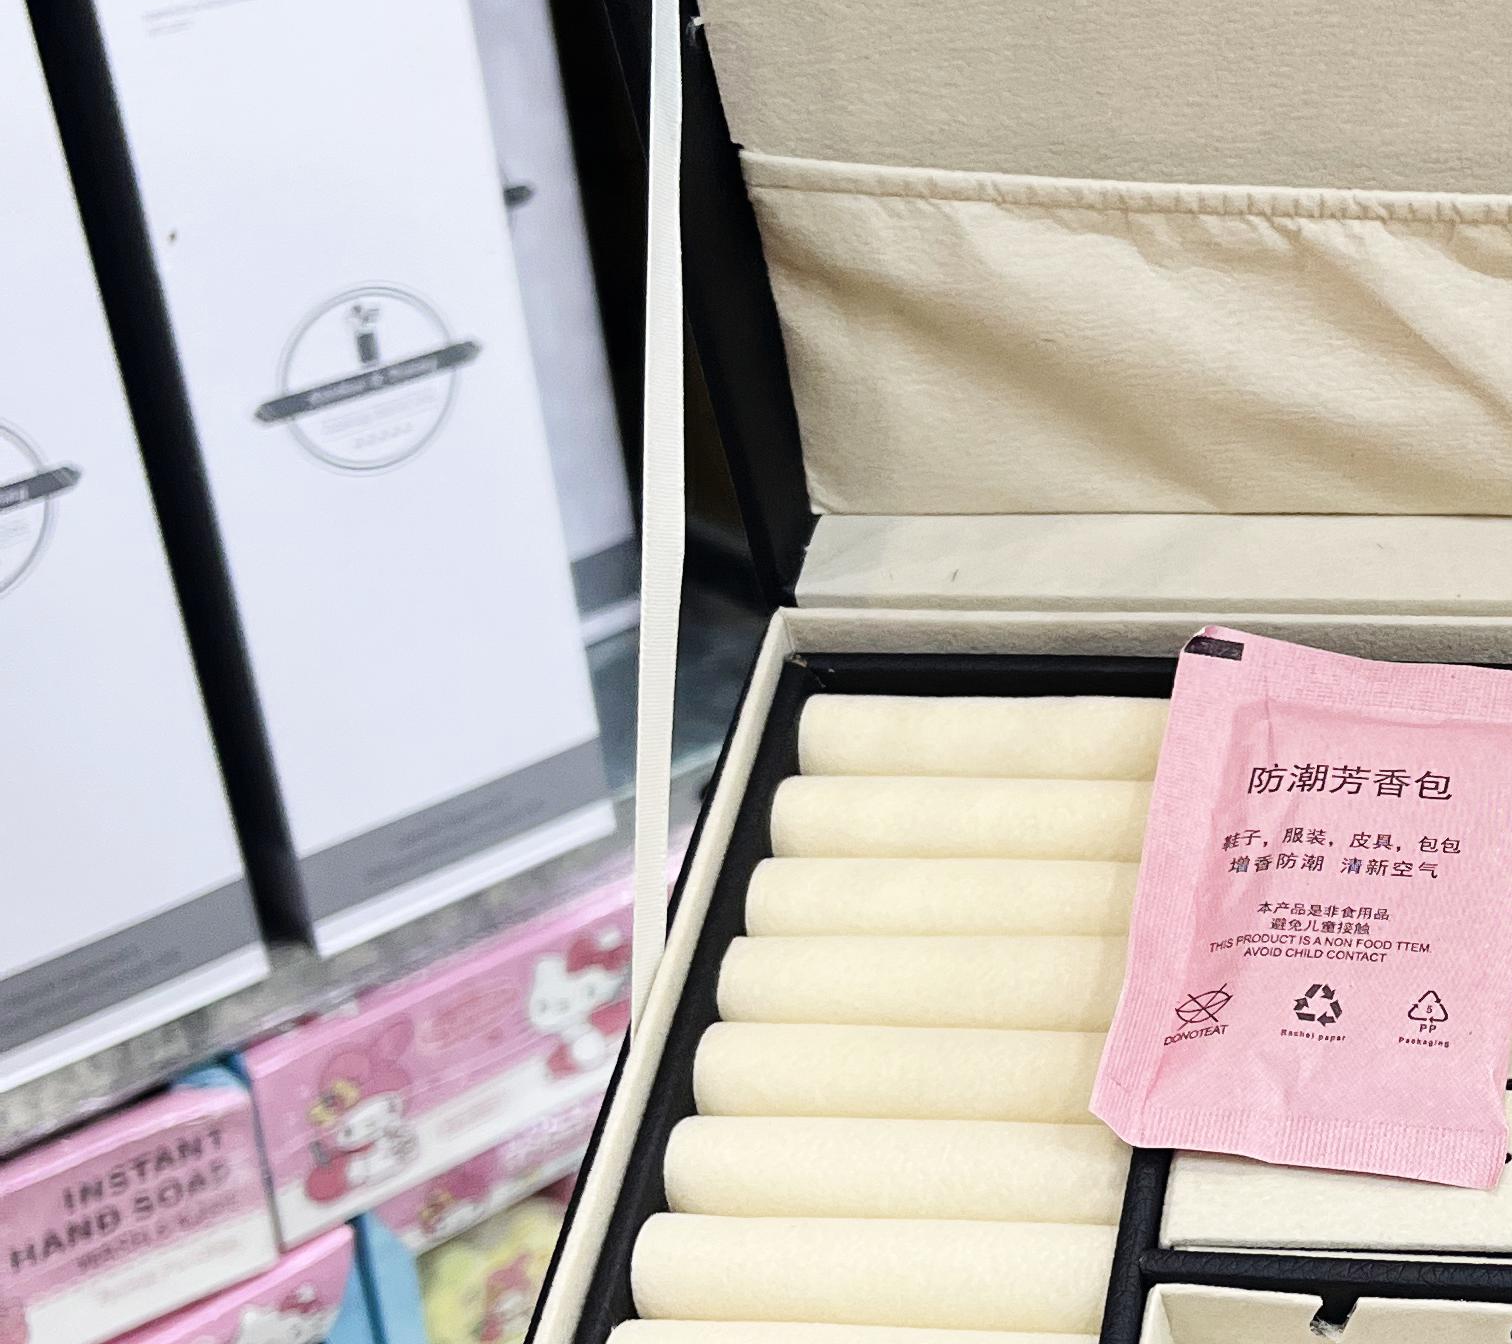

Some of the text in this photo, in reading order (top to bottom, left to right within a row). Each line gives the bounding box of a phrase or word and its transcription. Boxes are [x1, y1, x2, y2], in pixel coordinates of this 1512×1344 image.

[1247, 763, 1453, 801] 防潮芳香包
[1228, 853, 1439, 879] 增香防潮 清新空气
[1256, 901, 1390, 921] 本产品是非食用品
[1270, 917, 1371, 935] 避免儿童接触
[1209, 938, 1234, 953] THIS
[1236, 933, 1296, 947] PRODUCT
[1298, 935, 1311, 946] IS
[1315, 936, 1323, 946] A
[1324, 936, 1352, 949] NON
[1355, 938, 1392, 950] FOOD
[1243, 946, 1388, 963] AVOID CHILD CONTACT
[1419, 1023, 1437, 1034] PP
[63, 1127, 222, 1211] INSTANT
[10, 1206, 122, 1272] HAND
[132, 1158, 231, 1218] SOAP
